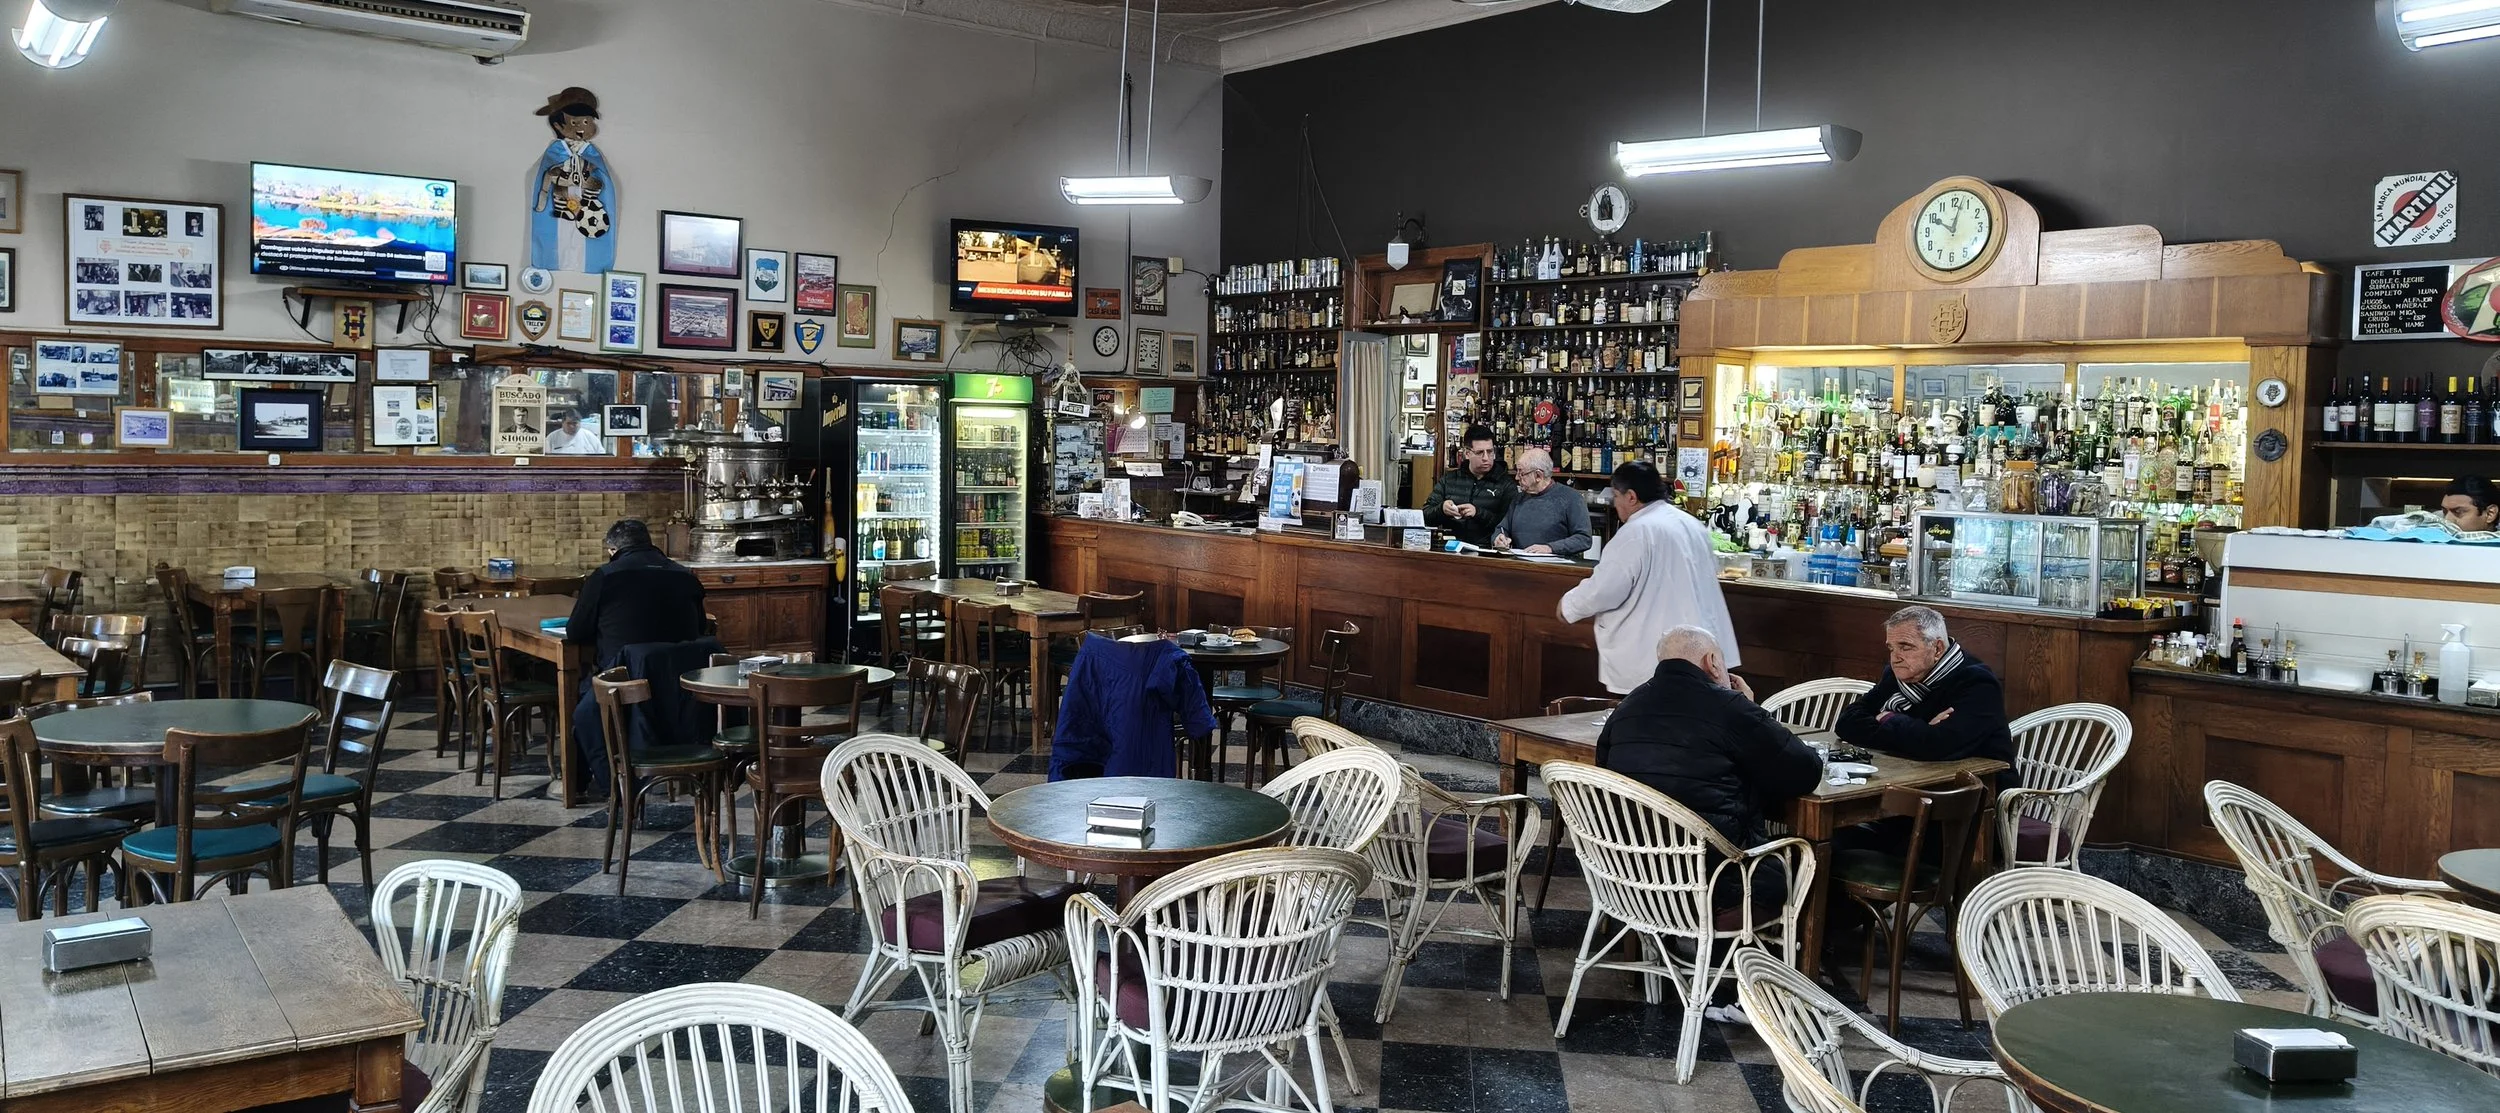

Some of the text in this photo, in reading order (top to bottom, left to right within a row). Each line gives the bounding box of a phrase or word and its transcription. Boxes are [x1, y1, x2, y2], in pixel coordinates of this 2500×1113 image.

[1951, 197, 1959, 208] 12
[2376, 176, 2428, 222] LA MARCA MUNDIAL
[1939, 202, 1946, 212] 11
[2380, 176, 2451, 242] MARTINI
[2438, 203, 2454, 218] SECO
[1929, 213, 1938, 224] 10
[1975, 208, 1980, 219] 2
[1925, 227, 1930, 237] 9
[1977, 222, 1983, 233] 3
[2429, 218, 2452, 240] BLANCO
[2412, 225, 2430, 243] DULCE
[1928, 240, 1933, 250] 8
[1937, 249, 1943, 260] 7
[1949, 252, 1955, 262] 6
[1962, 247, 1968, 258] 5
[499, 391, 541, 399] BUSCADO
[823, 398, 847, 427] Imperial
